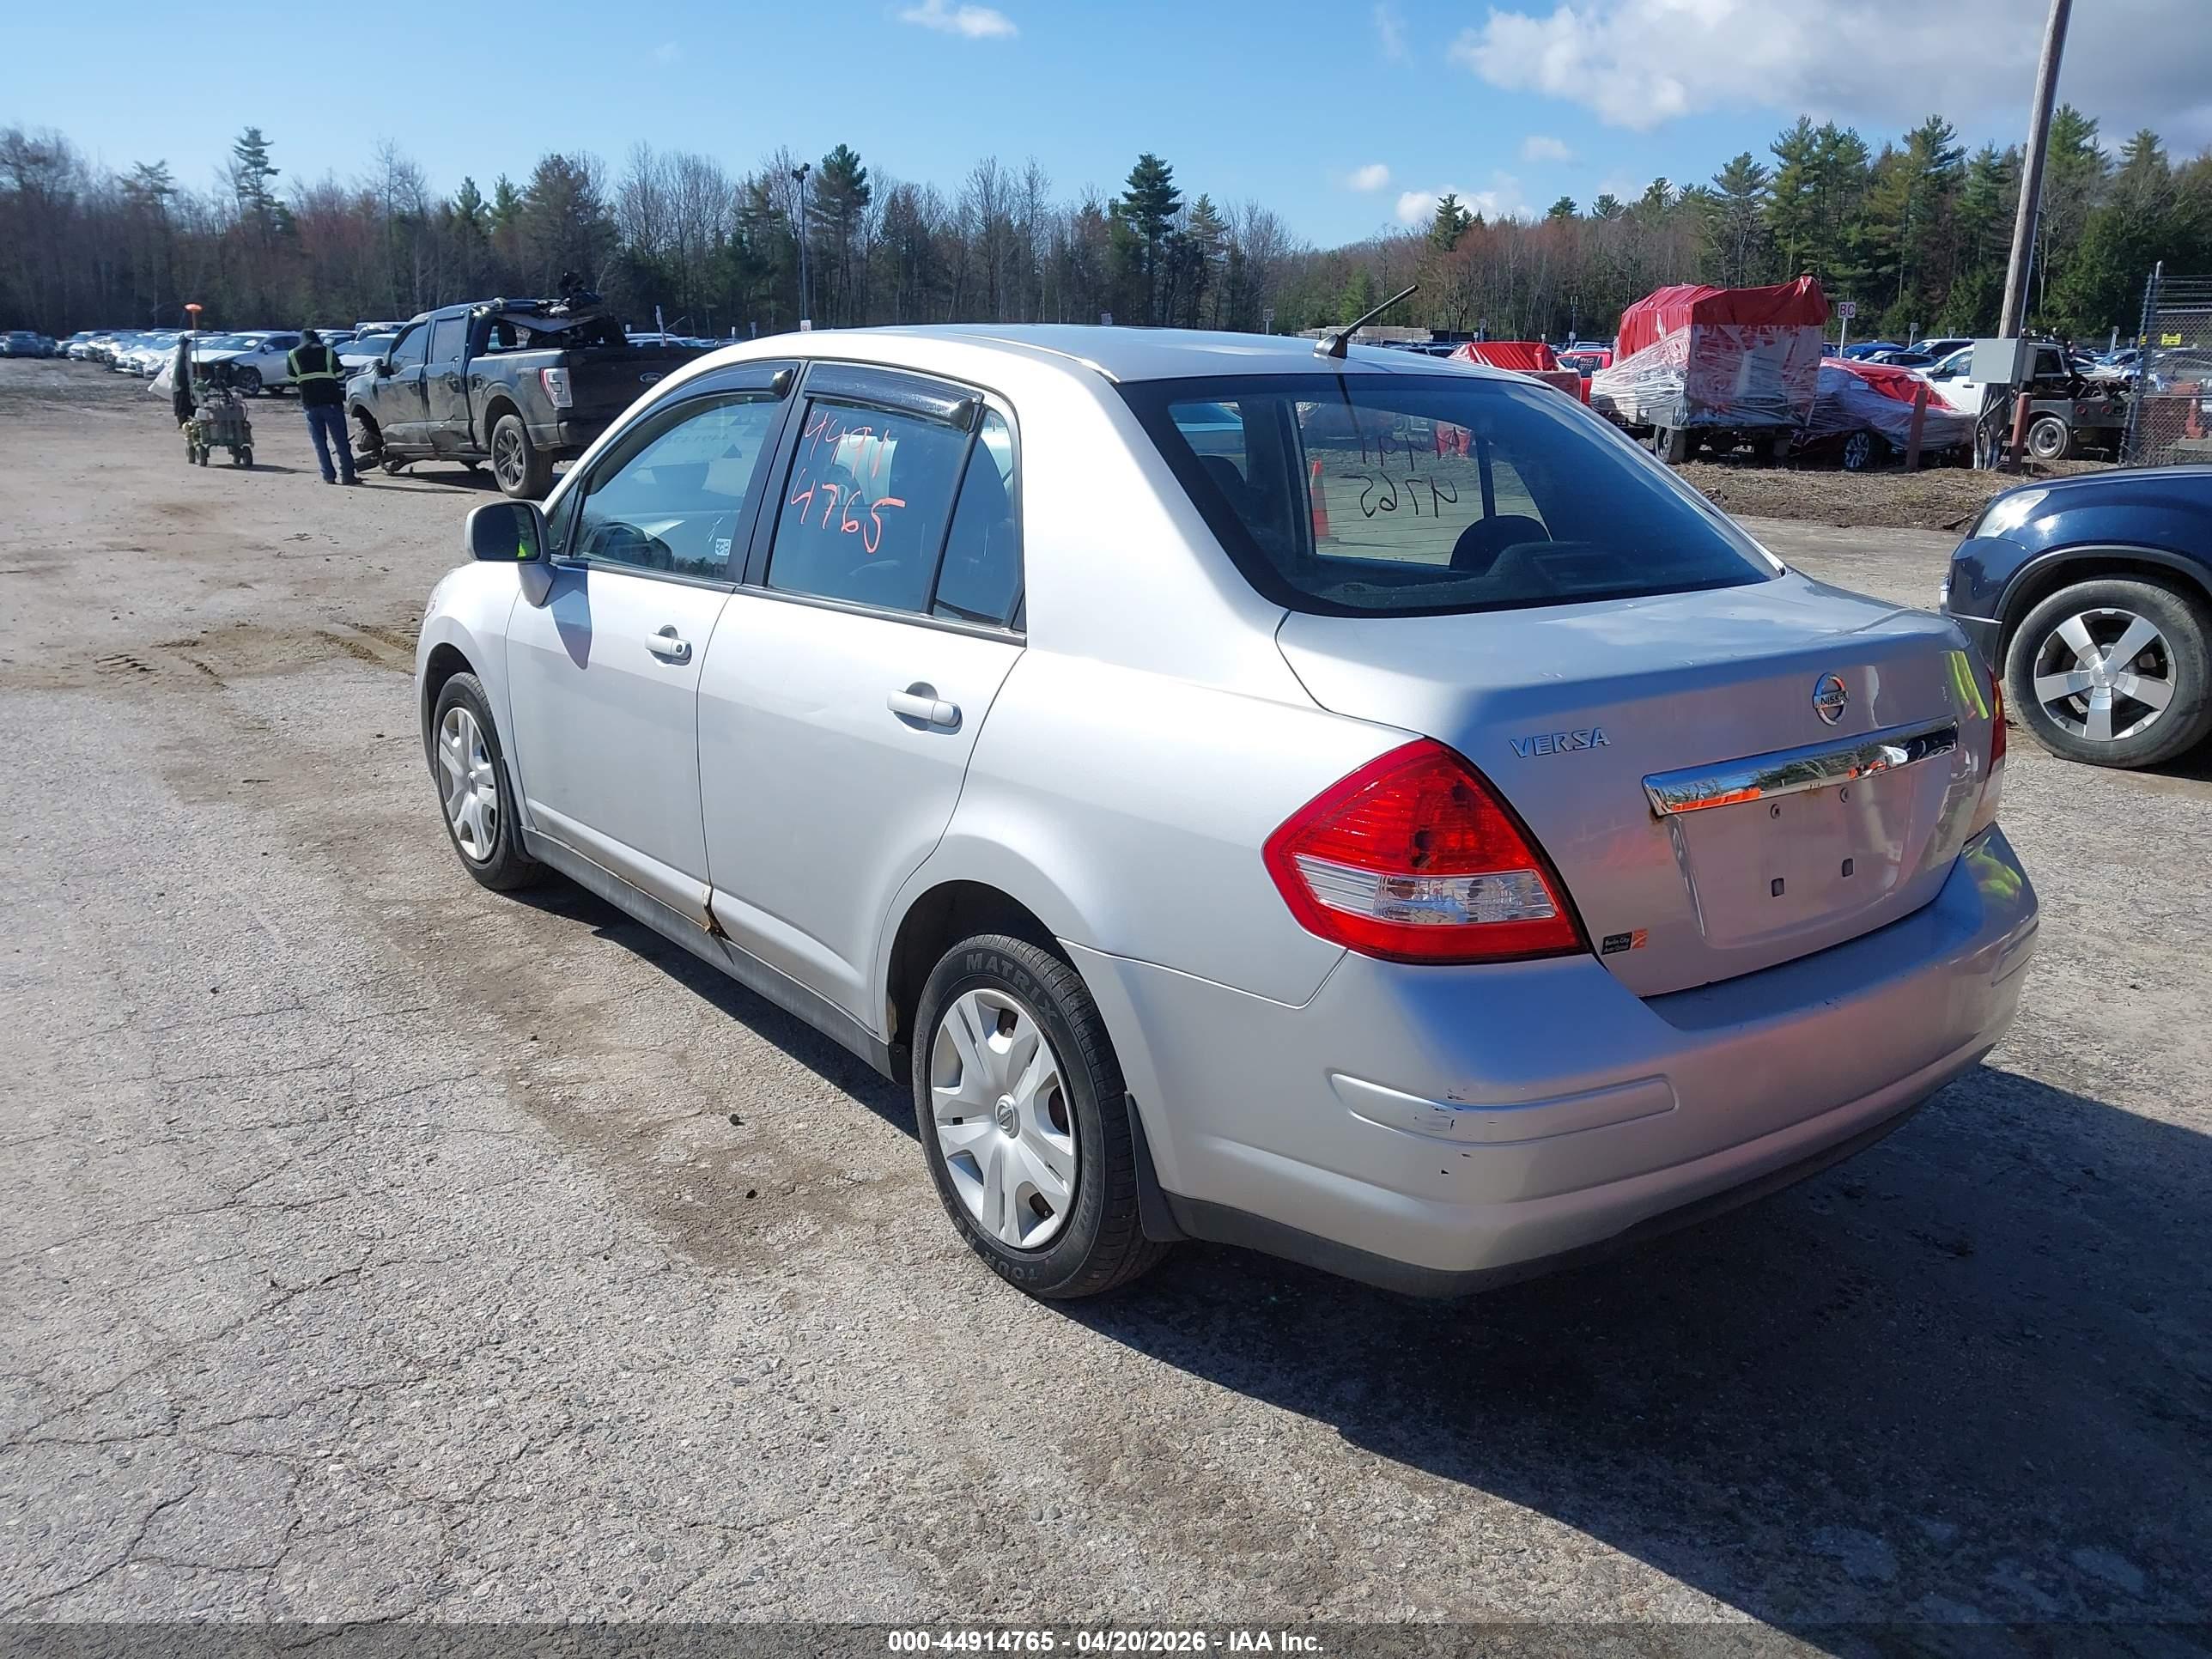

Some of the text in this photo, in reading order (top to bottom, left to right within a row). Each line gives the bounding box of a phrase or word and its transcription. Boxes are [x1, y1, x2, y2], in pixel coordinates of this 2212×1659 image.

[1840, 303, 1855, 316] BC
[805, 410, 890, 481] 4491
[790, 467, 907, 554] 4765
[1510, 726, 1612, 758] VERSA
[966, 952, 1058, 1022] MATRIX
